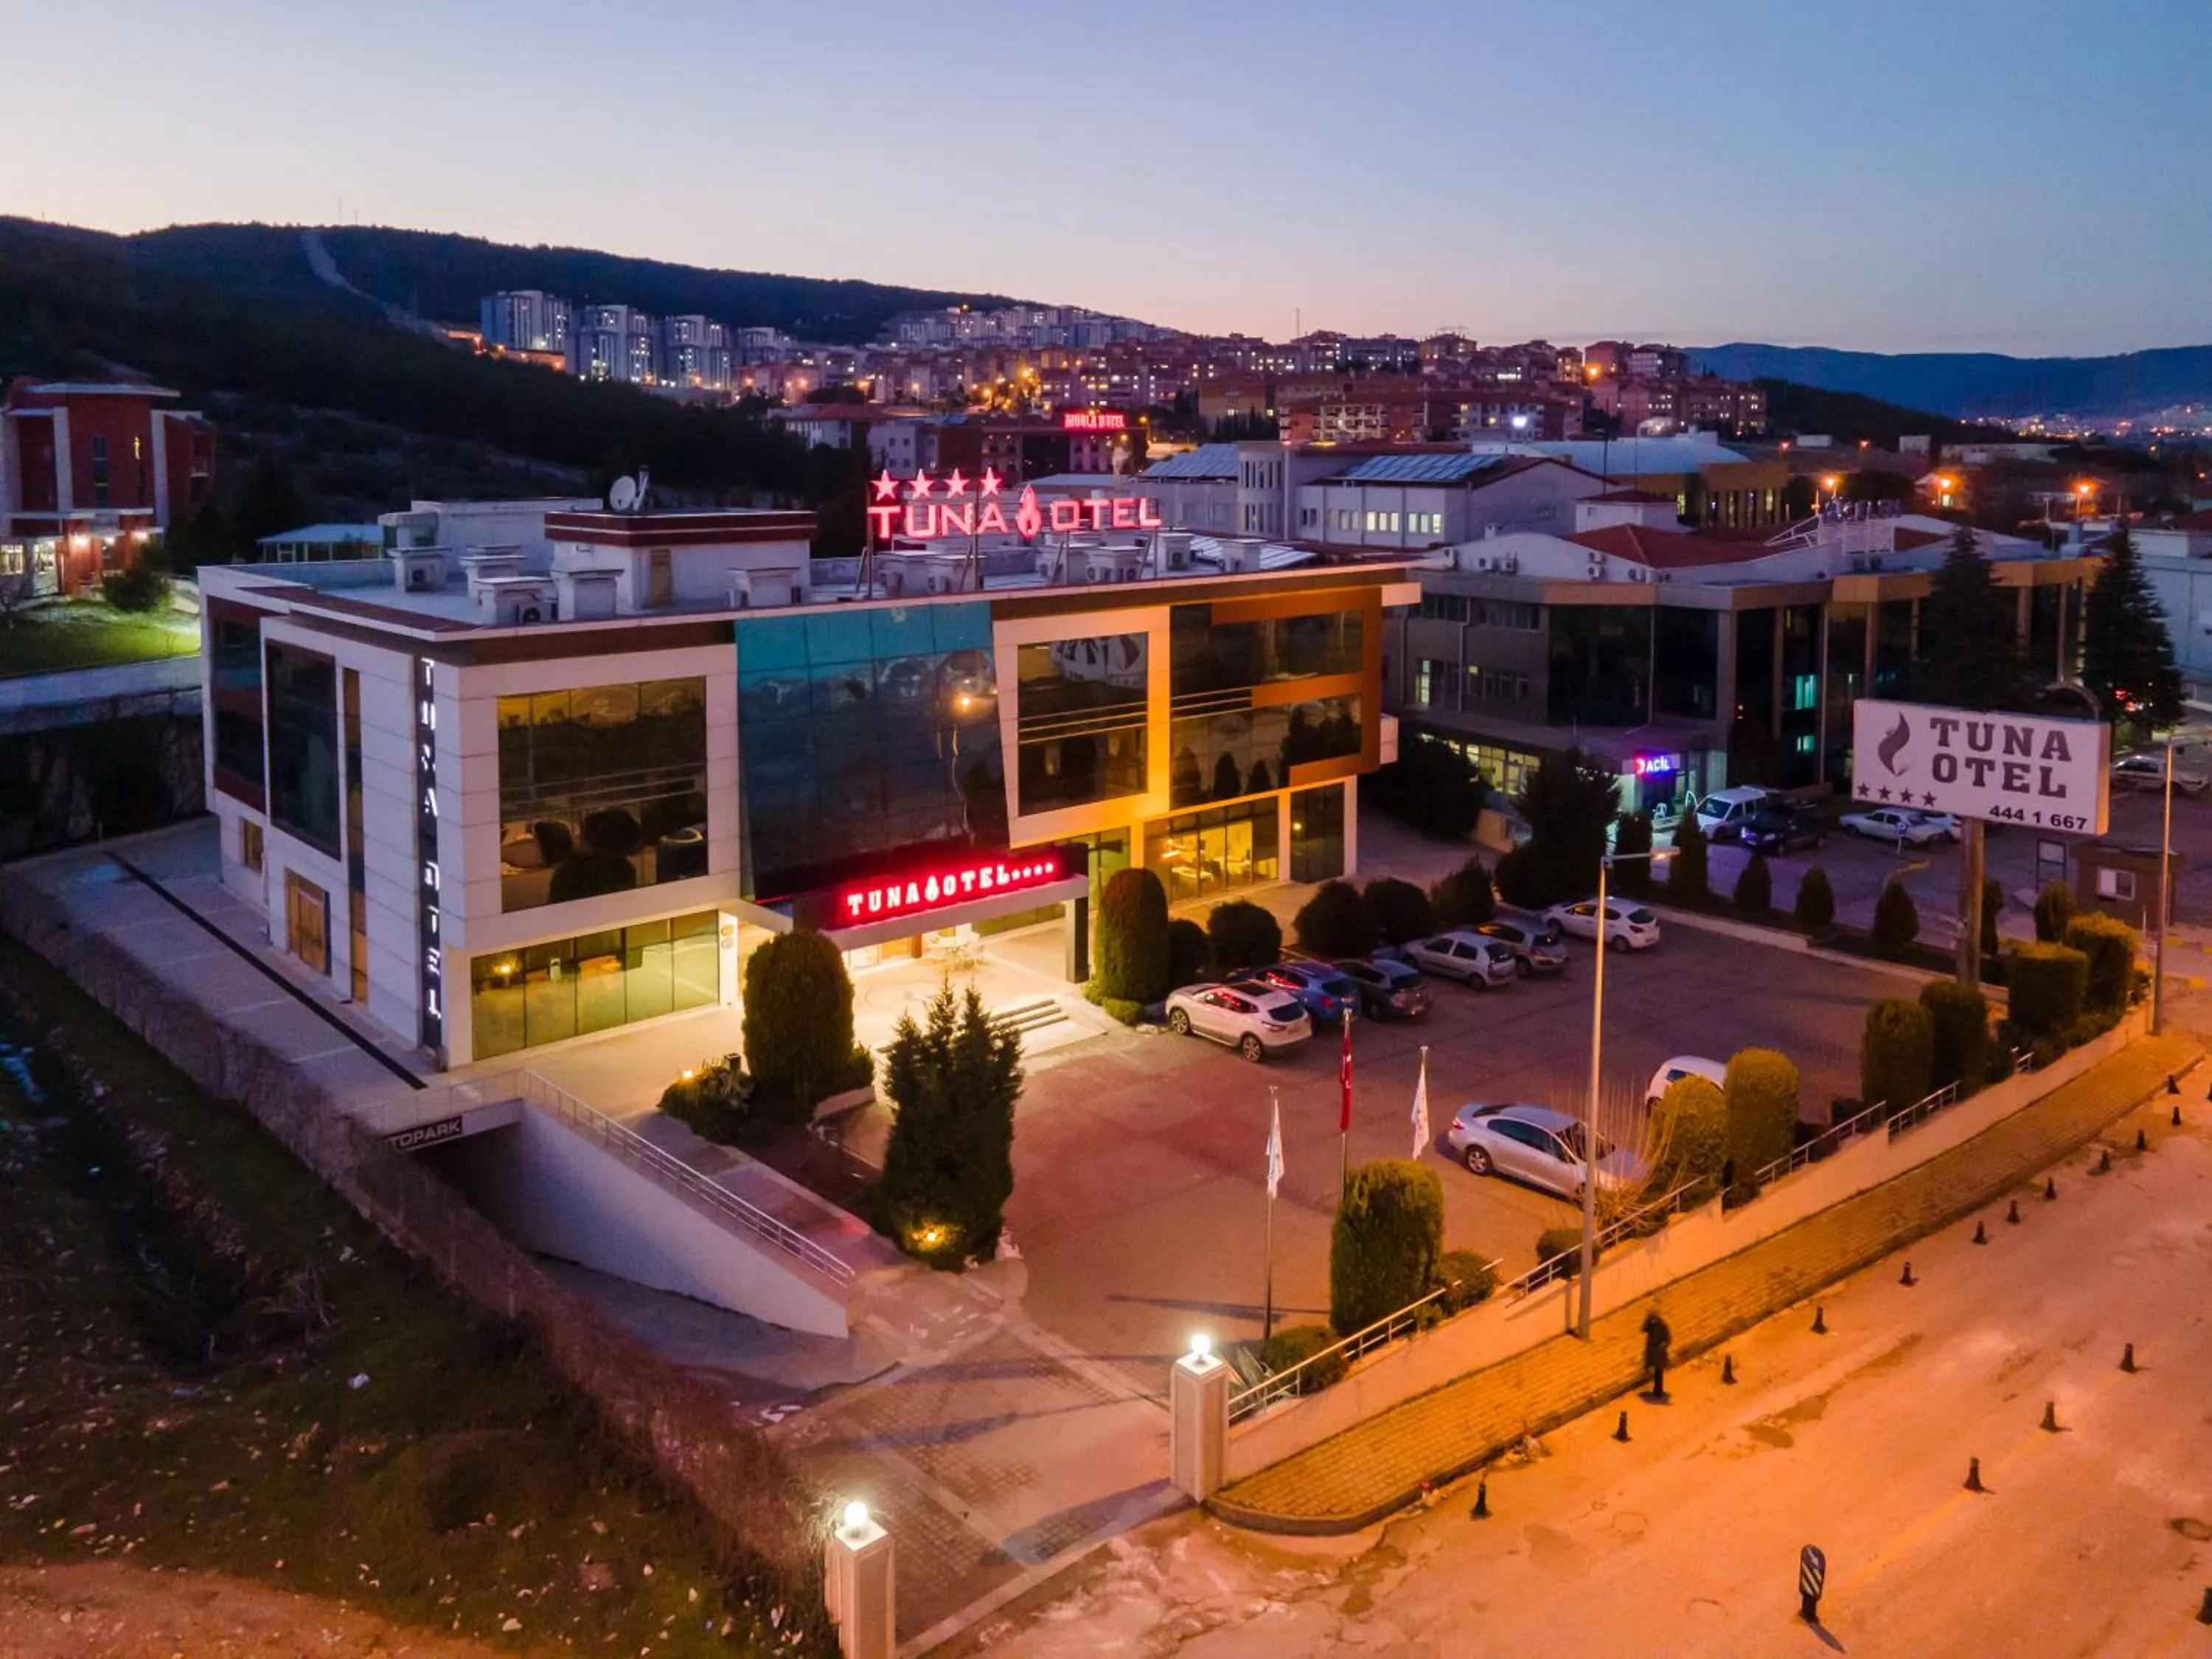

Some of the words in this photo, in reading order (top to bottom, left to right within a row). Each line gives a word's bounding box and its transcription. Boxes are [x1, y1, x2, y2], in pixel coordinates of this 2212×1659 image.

[867, 503, 1009, 540] TUNA
[1050, 498, 1162, 531] OTEL
[1930, 717, 2072, 762] TUNA
[1932, 753, 2067, 799] OTEL
[1989, 805, 2025, 821] 444
[2032, 810, 2042, 824] 1
[2050, 813, 2088, 830] 667
[847, 882, 919, 916] TUNA
[943, 864, 1010, 897] OTEL
